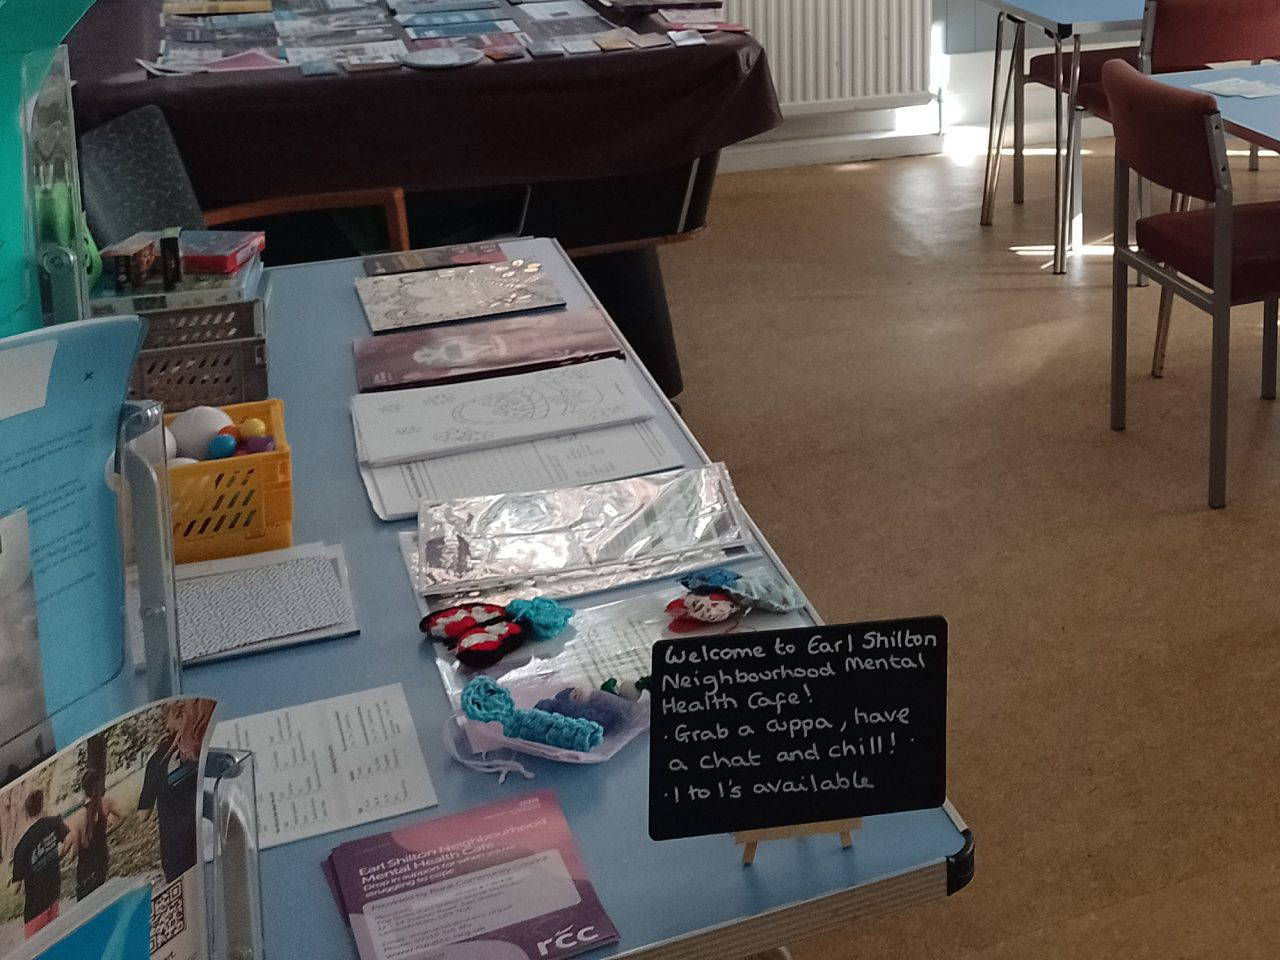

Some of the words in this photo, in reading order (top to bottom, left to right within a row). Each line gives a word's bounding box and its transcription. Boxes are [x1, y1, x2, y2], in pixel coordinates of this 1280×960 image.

[665, 645, 767, 665] Welcome
[775, 639, 796, 656] to
[807, 635, 853, 655] Earl
[863, 629, 937, 650] Shilton
[661, 665, 836, 695] Neighbourhood
[845, 653, 926, 673] Mental
[661, 691, 738, 715] Health
[747, 684, 814, 714] Cafe!
[675, 722, 729, 742] Grab
[738, 725, 754, 736] a
[854, 707, 910, 725] have
[669, 757, 688, 772] a
[700, 751, 763, 770] chat
[777, 743, 820, 762] and
[829, 734, 896, 758] chill!
[689, 785, 710, 801] to
[753, 770, 875, 794] available
[359, 862, 385, 876] Earl
[387, 850, 436, 867] Shilton
[439, 817, 547, 851] Neighbourhood
[362, 864, 411, 884] Mental
[414, 852, 460, 869] Health
[536, 925, 599, 957] rcc
